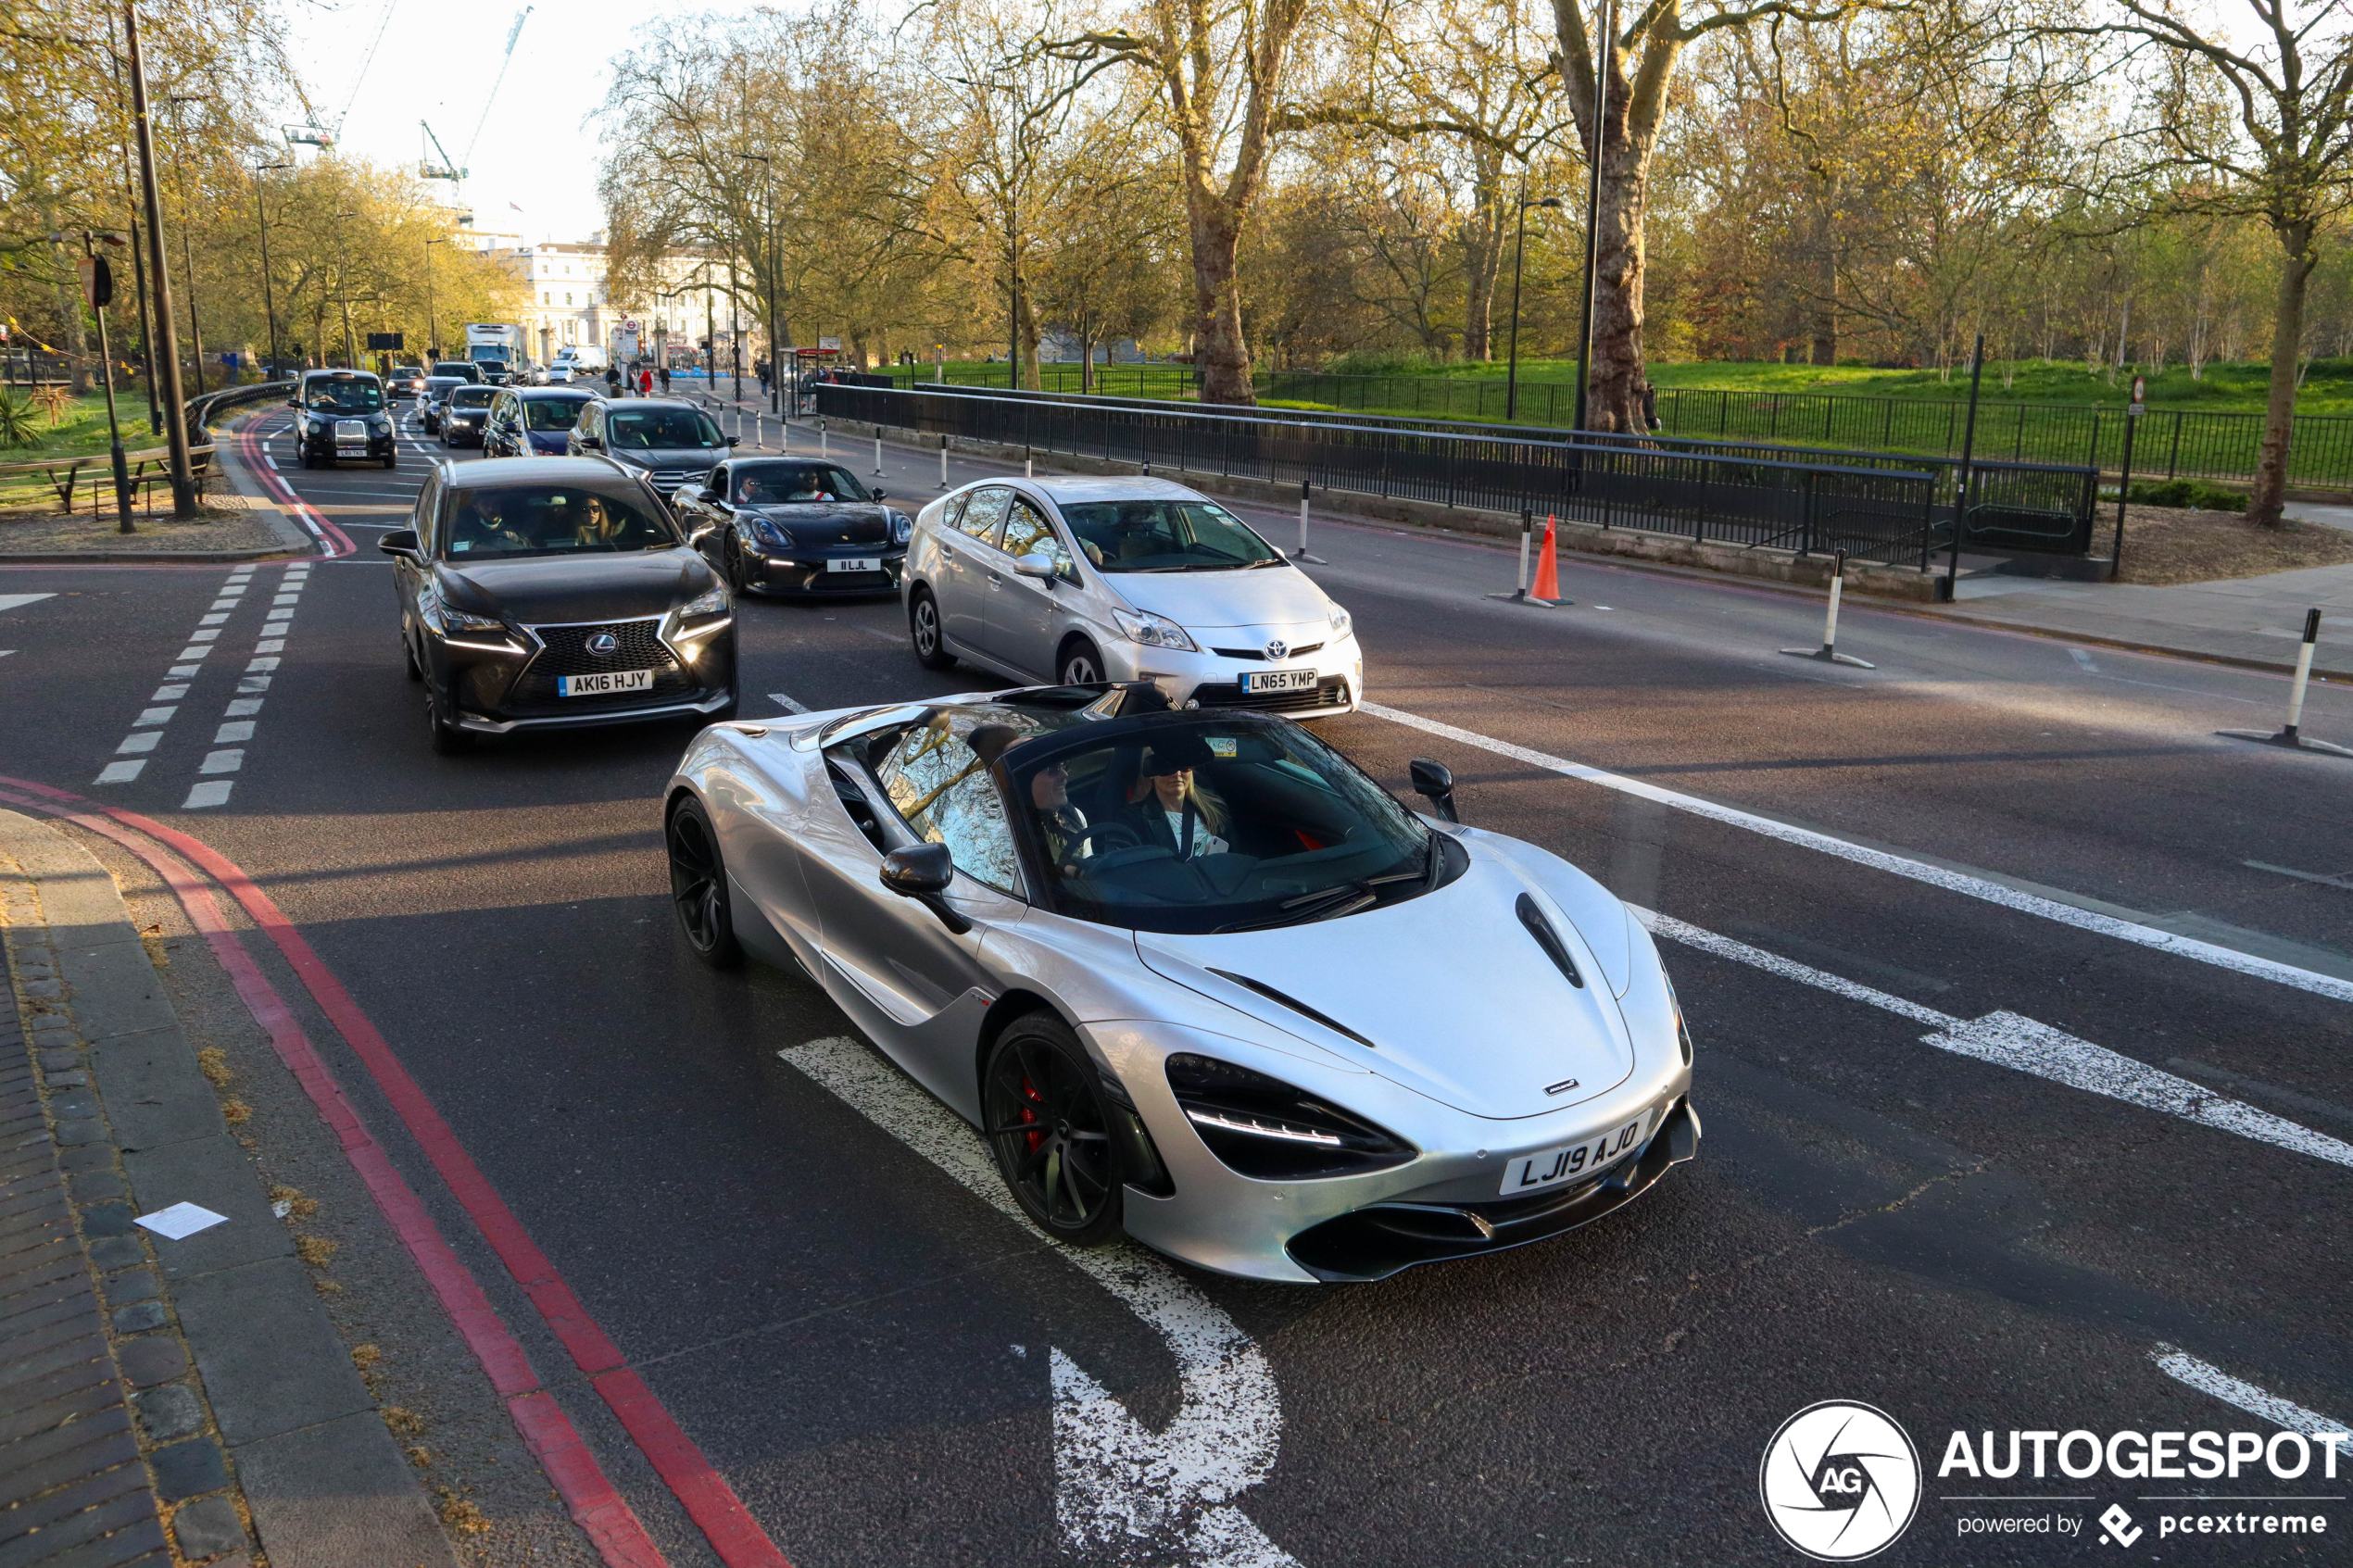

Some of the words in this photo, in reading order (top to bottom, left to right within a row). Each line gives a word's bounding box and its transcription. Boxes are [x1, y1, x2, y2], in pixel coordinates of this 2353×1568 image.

[849, 560, 867, 571] LJL
[574, 675, 610, 693] AK16
[614, 671, 646, 689] HJY
[1252, 673, 1287, 690] LN65
[1290, 671, 1315, 687] YMP
[1520, 1146, 1589, 1186] LJ19
[1591, 1122, 1639, 1167] AJO
